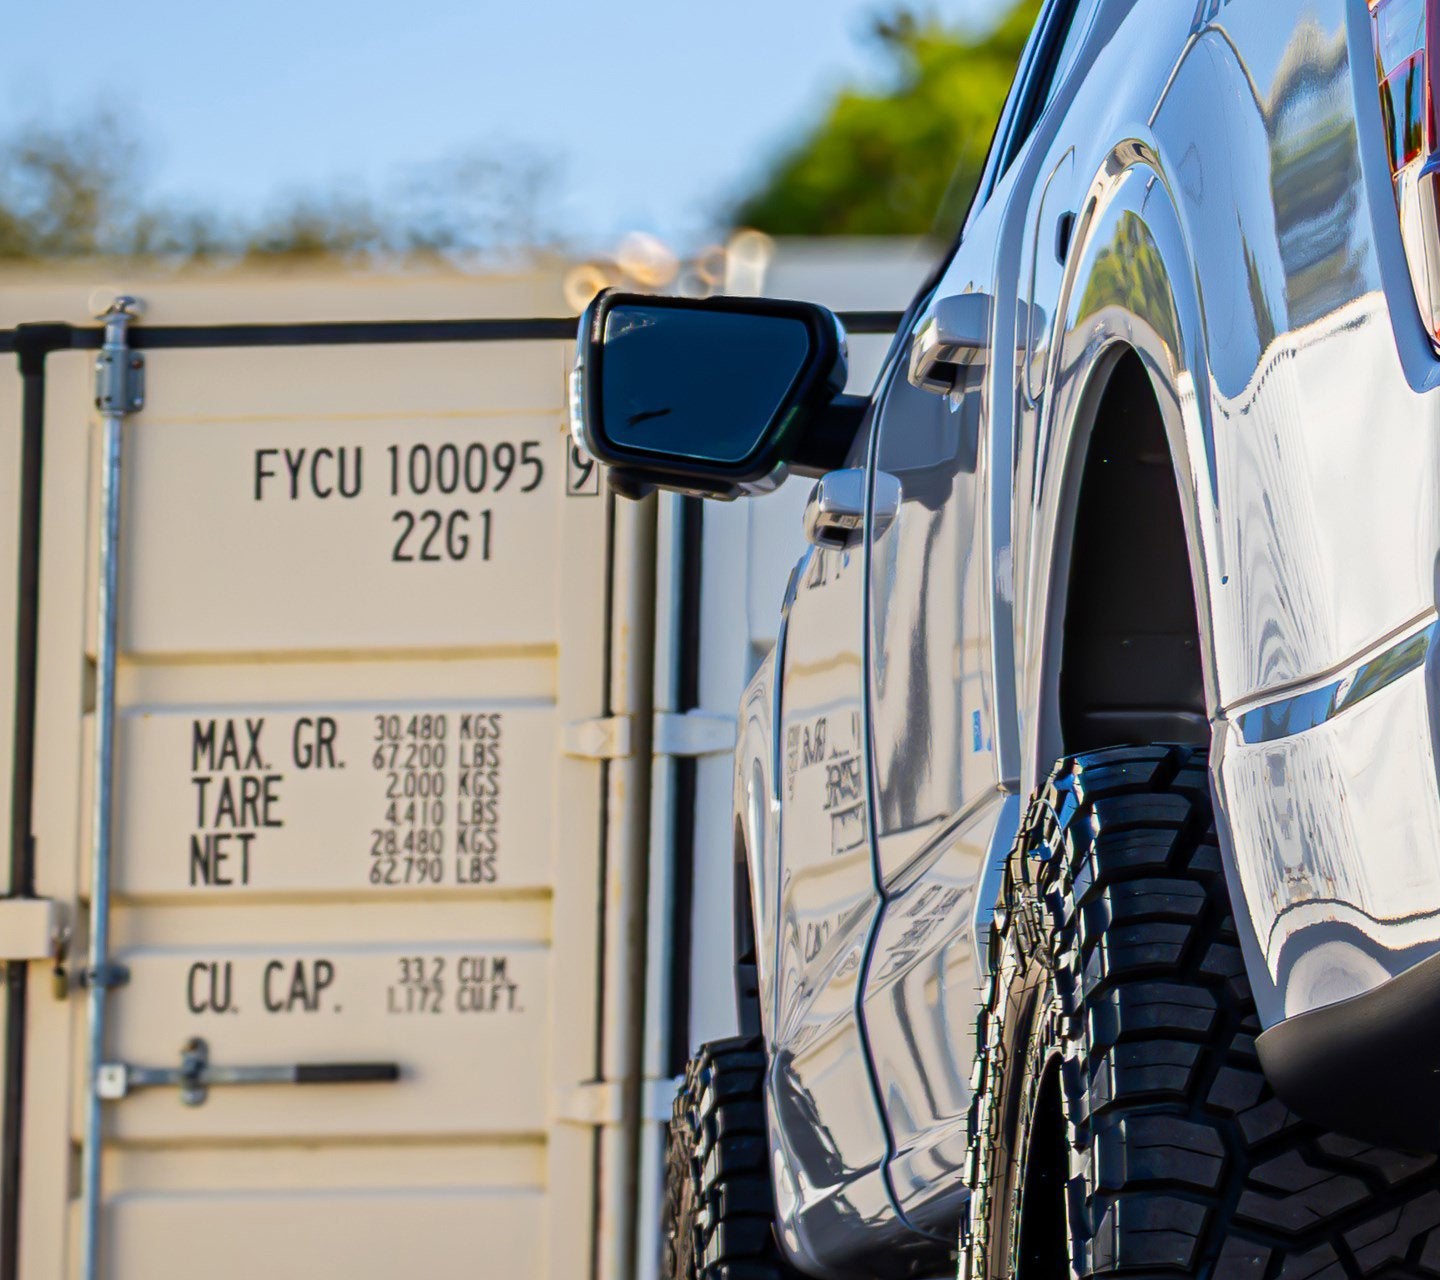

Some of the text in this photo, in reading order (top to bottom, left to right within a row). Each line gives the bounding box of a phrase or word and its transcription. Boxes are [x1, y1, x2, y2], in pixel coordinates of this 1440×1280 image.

[255, 447, 362, 500] FYCU
[387, 441, 543, 496] 100095
[391, 509, 491, 561] 22G1
[193, 714, 502, 771] MAX. GR. 30.480 KGS
[373, 742, 500, 770] 67.200 LBS
[191, 775, 284, 827] TARE
[458, 772, 499, 797] KGS
[457, 800, 498, 826] LBS
[190, 832, 256, 886] NET
[456, 829, 498, 854] KGS
[456, 857, 497, 883] LBS
[187, 961, 238, 1013] CU.
[264, 960, 341, 1013] CAP.
